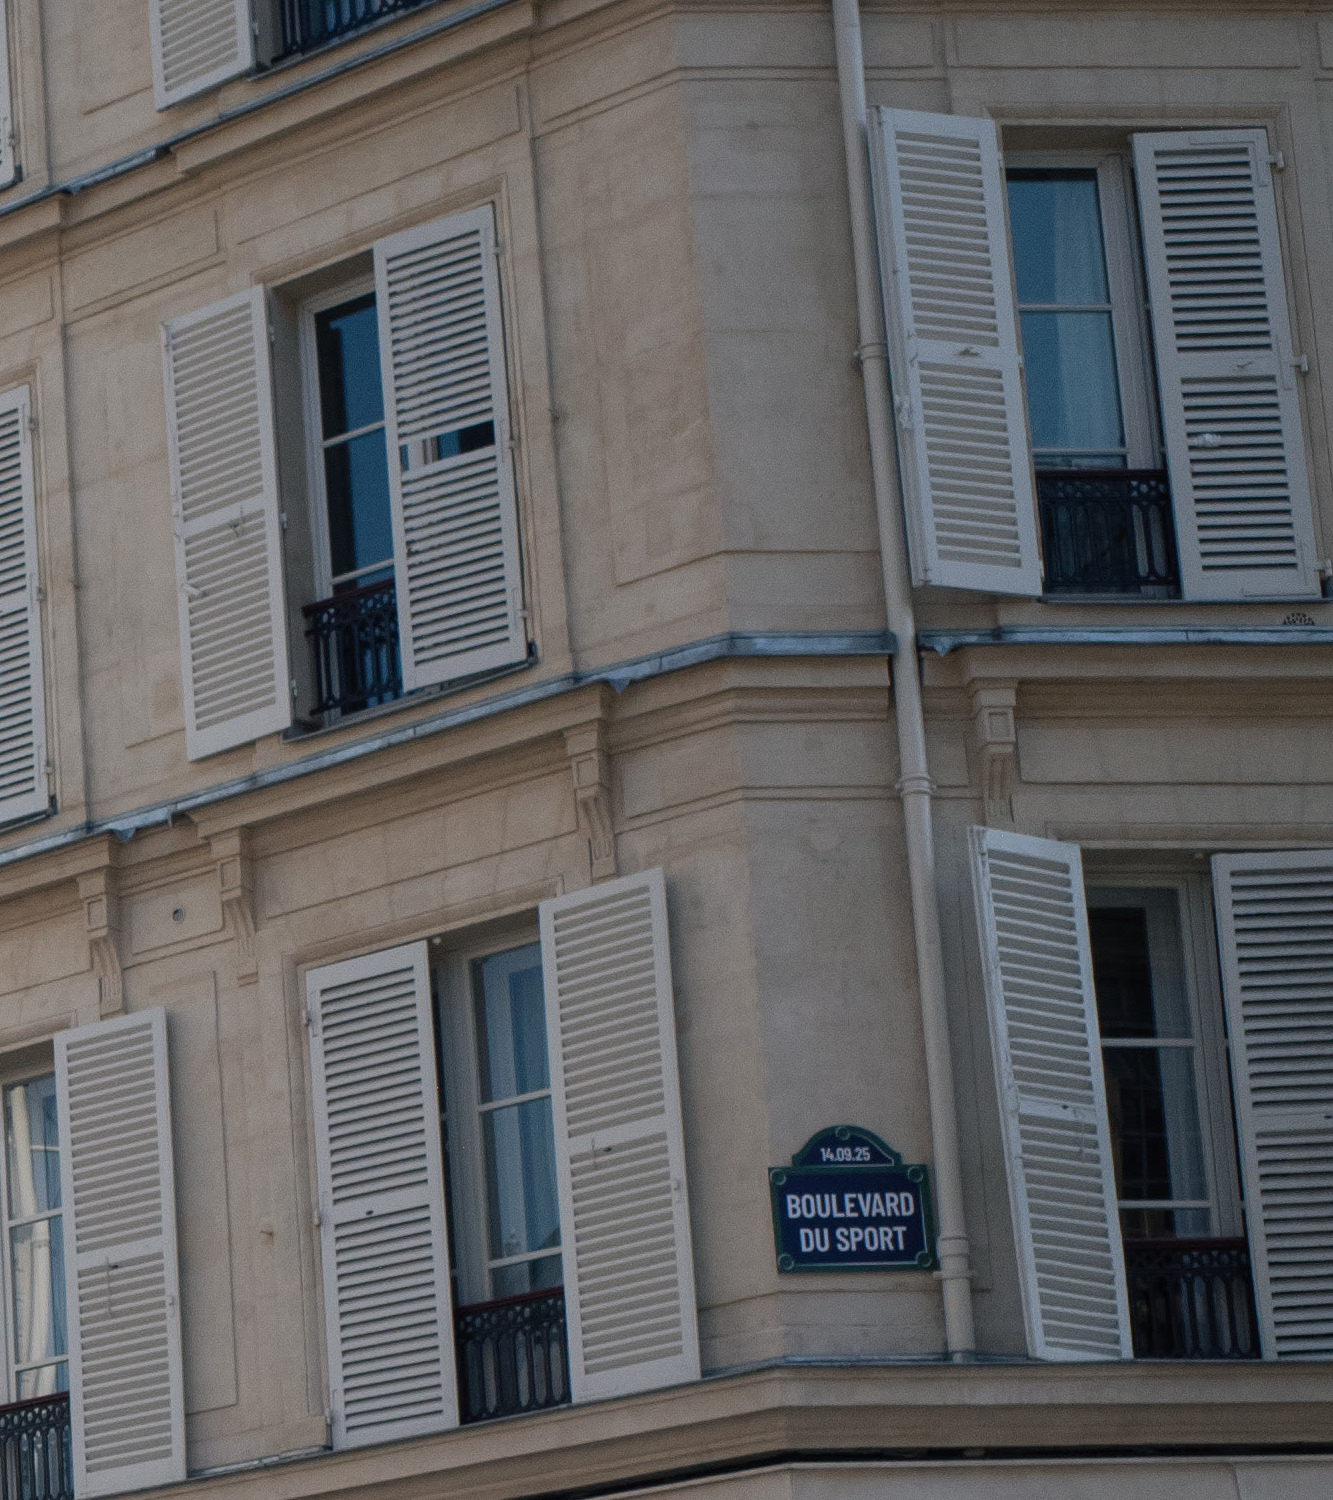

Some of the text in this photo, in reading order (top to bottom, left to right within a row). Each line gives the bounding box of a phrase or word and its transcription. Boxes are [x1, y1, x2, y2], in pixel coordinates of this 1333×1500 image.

[820, 1147, 870, 1162] 14.09.25
[786, 1192, 915, 1219] BOULEVARD
[799, 1226, 907, 1252] DU SPORT
